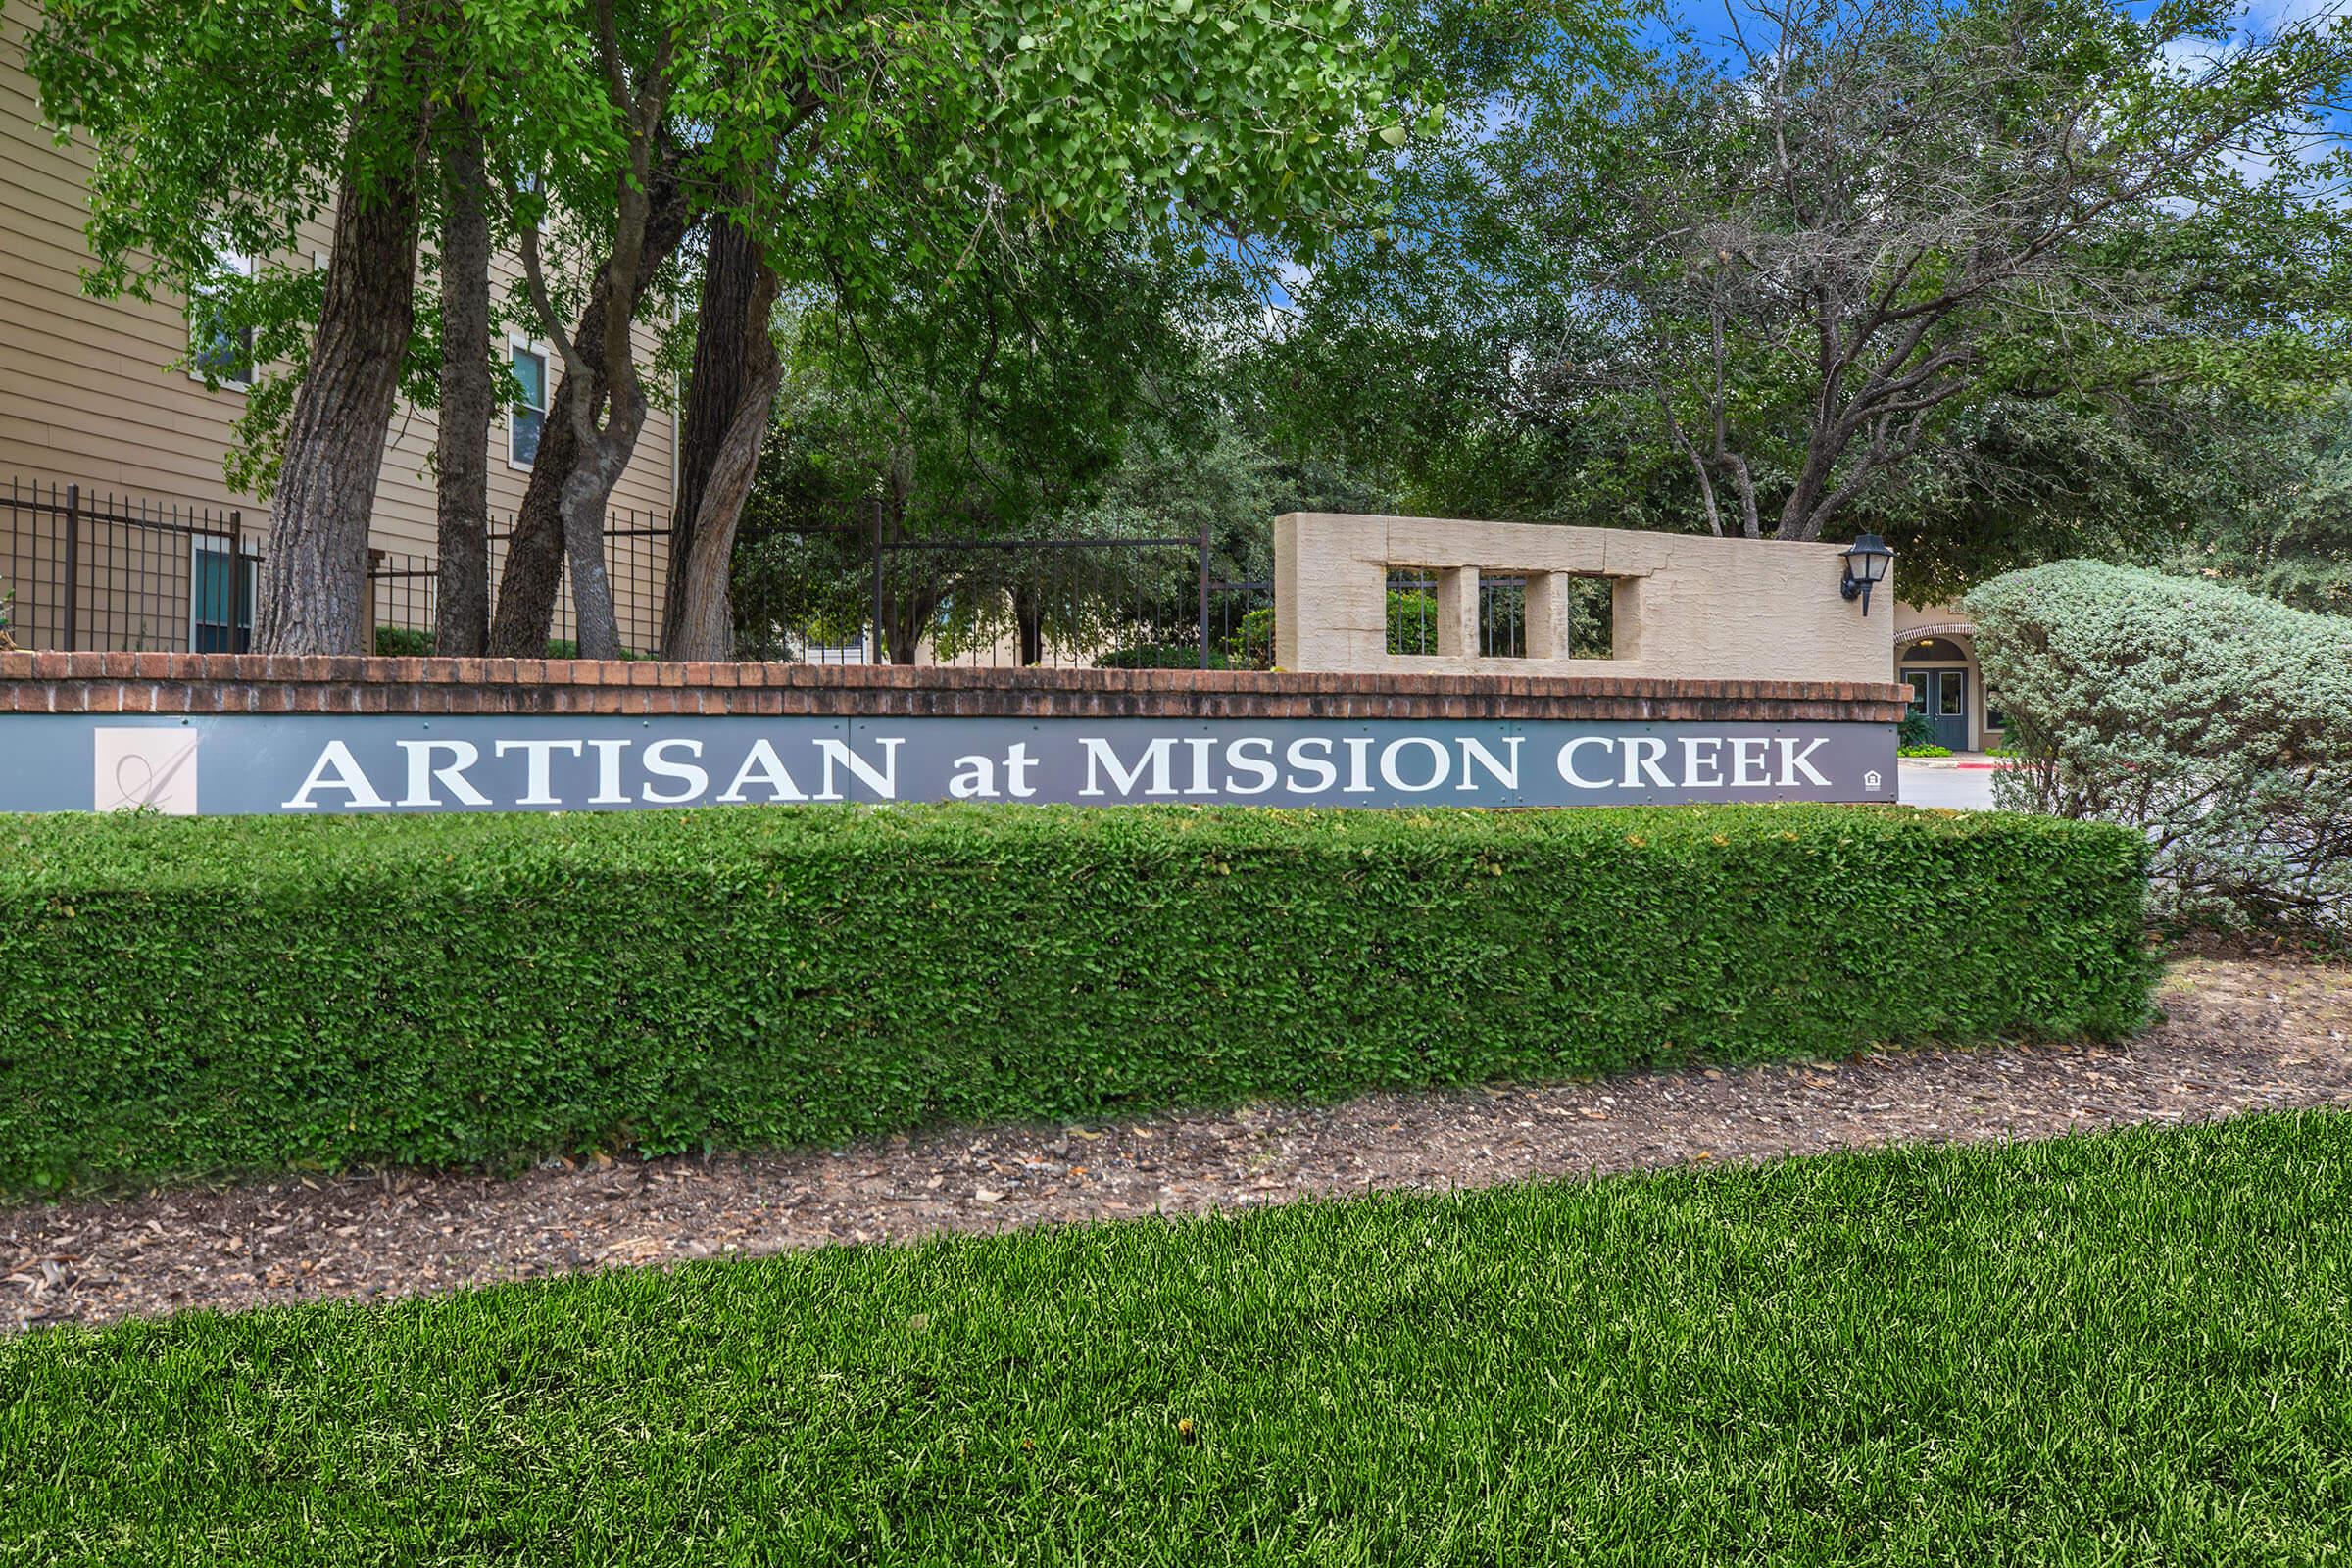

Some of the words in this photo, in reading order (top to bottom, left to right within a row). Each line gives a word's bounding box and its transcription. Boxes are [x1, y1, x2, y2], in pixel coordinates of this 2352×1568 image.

[281, 737, 906, 808] ARTISAN
[949, 742, 1040, 798] at
[1078, 737, 1526, 796] MISSION
[1556, 736, 1832, 789] CREEK
